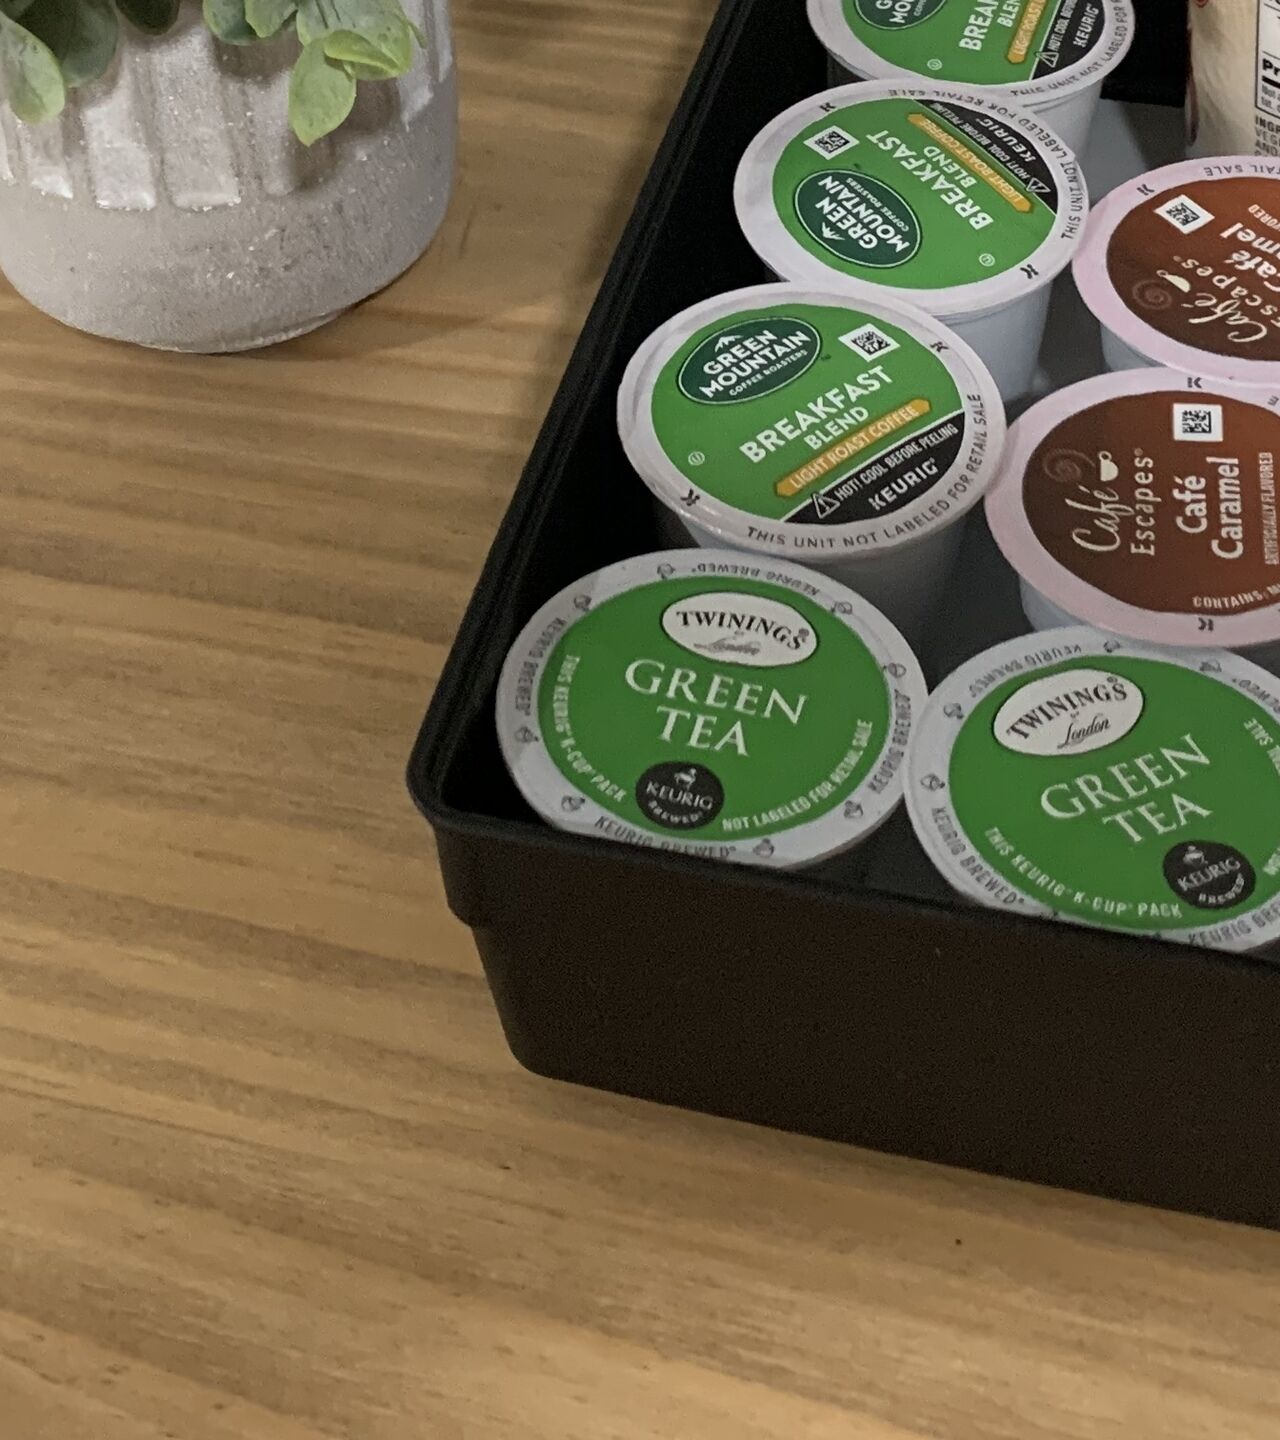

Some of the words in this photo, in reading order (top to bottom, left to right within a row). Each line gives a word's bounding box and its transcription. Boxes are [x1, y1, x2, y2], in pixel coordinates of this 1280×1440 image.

[1073, 4, 1099, 48] KEURIG
[976, 118, 1036, 161] KEURIG
[867, 130, 994, 231] BREAKFAST
[923, 146, 976, 188] BLEND
[815, 200, 877, 249] GREEN
[818, 176, 910, 252] MOUNTAIN
[1183, 292, 1268, 342] Café
[698, 330, 810, 399] MOUNTAIN
[702, 330, 778, 375] GREEN
[729, 376, 764, 397] COFFEE
[762, 349, 808, 380] ROASTERS
[738, 366, 894, 463] BREAKFAST
[804, 406, 870, 451] BLEND
[967, 393, 987, 425] SALE
[789, 460, 832, 489] LIGHT
[828, 431, 873, 465] ROAST
[869, 406, 918, 438] COFFEE
[834, 479, 861, 502] HOT!
[859, 460, 888, 485] COOL
[884, 443, 922, 469] BEFORE
[918, 423, 959, 449] PEELING
[966, 427, 988, 474] RETAIL
[868, 460, 937, 511] KEURIG
[947, 474, 975, 502] FOR
[1130, 456, 1162, 556] Escapes
[1173, 475, 1207, 534] Café
[1206, 456, 1244, 560] Caramel
[747, 527, 786, 546] THIS
[794, 536, 835, 549] UNIT
[843, 531, 877, 547] NOT
[884, 498, 949, 539] LABELED
[1065, 485, 1135, 552] Café
[1192, 590, 1267, 609] CONTAINS:
[677, 610, 805, 650] TWININGS
[625, 658, 808, 725] GREEN
[1005, 681, 1128, 741] TWININGS
[656, 705, 749, 757] TEA
[1057, 715, 1111, 749] London
[645, 781, 714, 811] KEURIG
[1040, 733, 1211, 820] GREEN
[1101, 793, 1214, 844] TEA
[984, 826, 1011, 856] THIS
[1013, 854, 1064, 898] KEURIG
[1073, 890, 1127, 915] K-CUP
[1138, 903, 1182, 918] PACK
[1177, 855, 1242, 892] KEURIG
